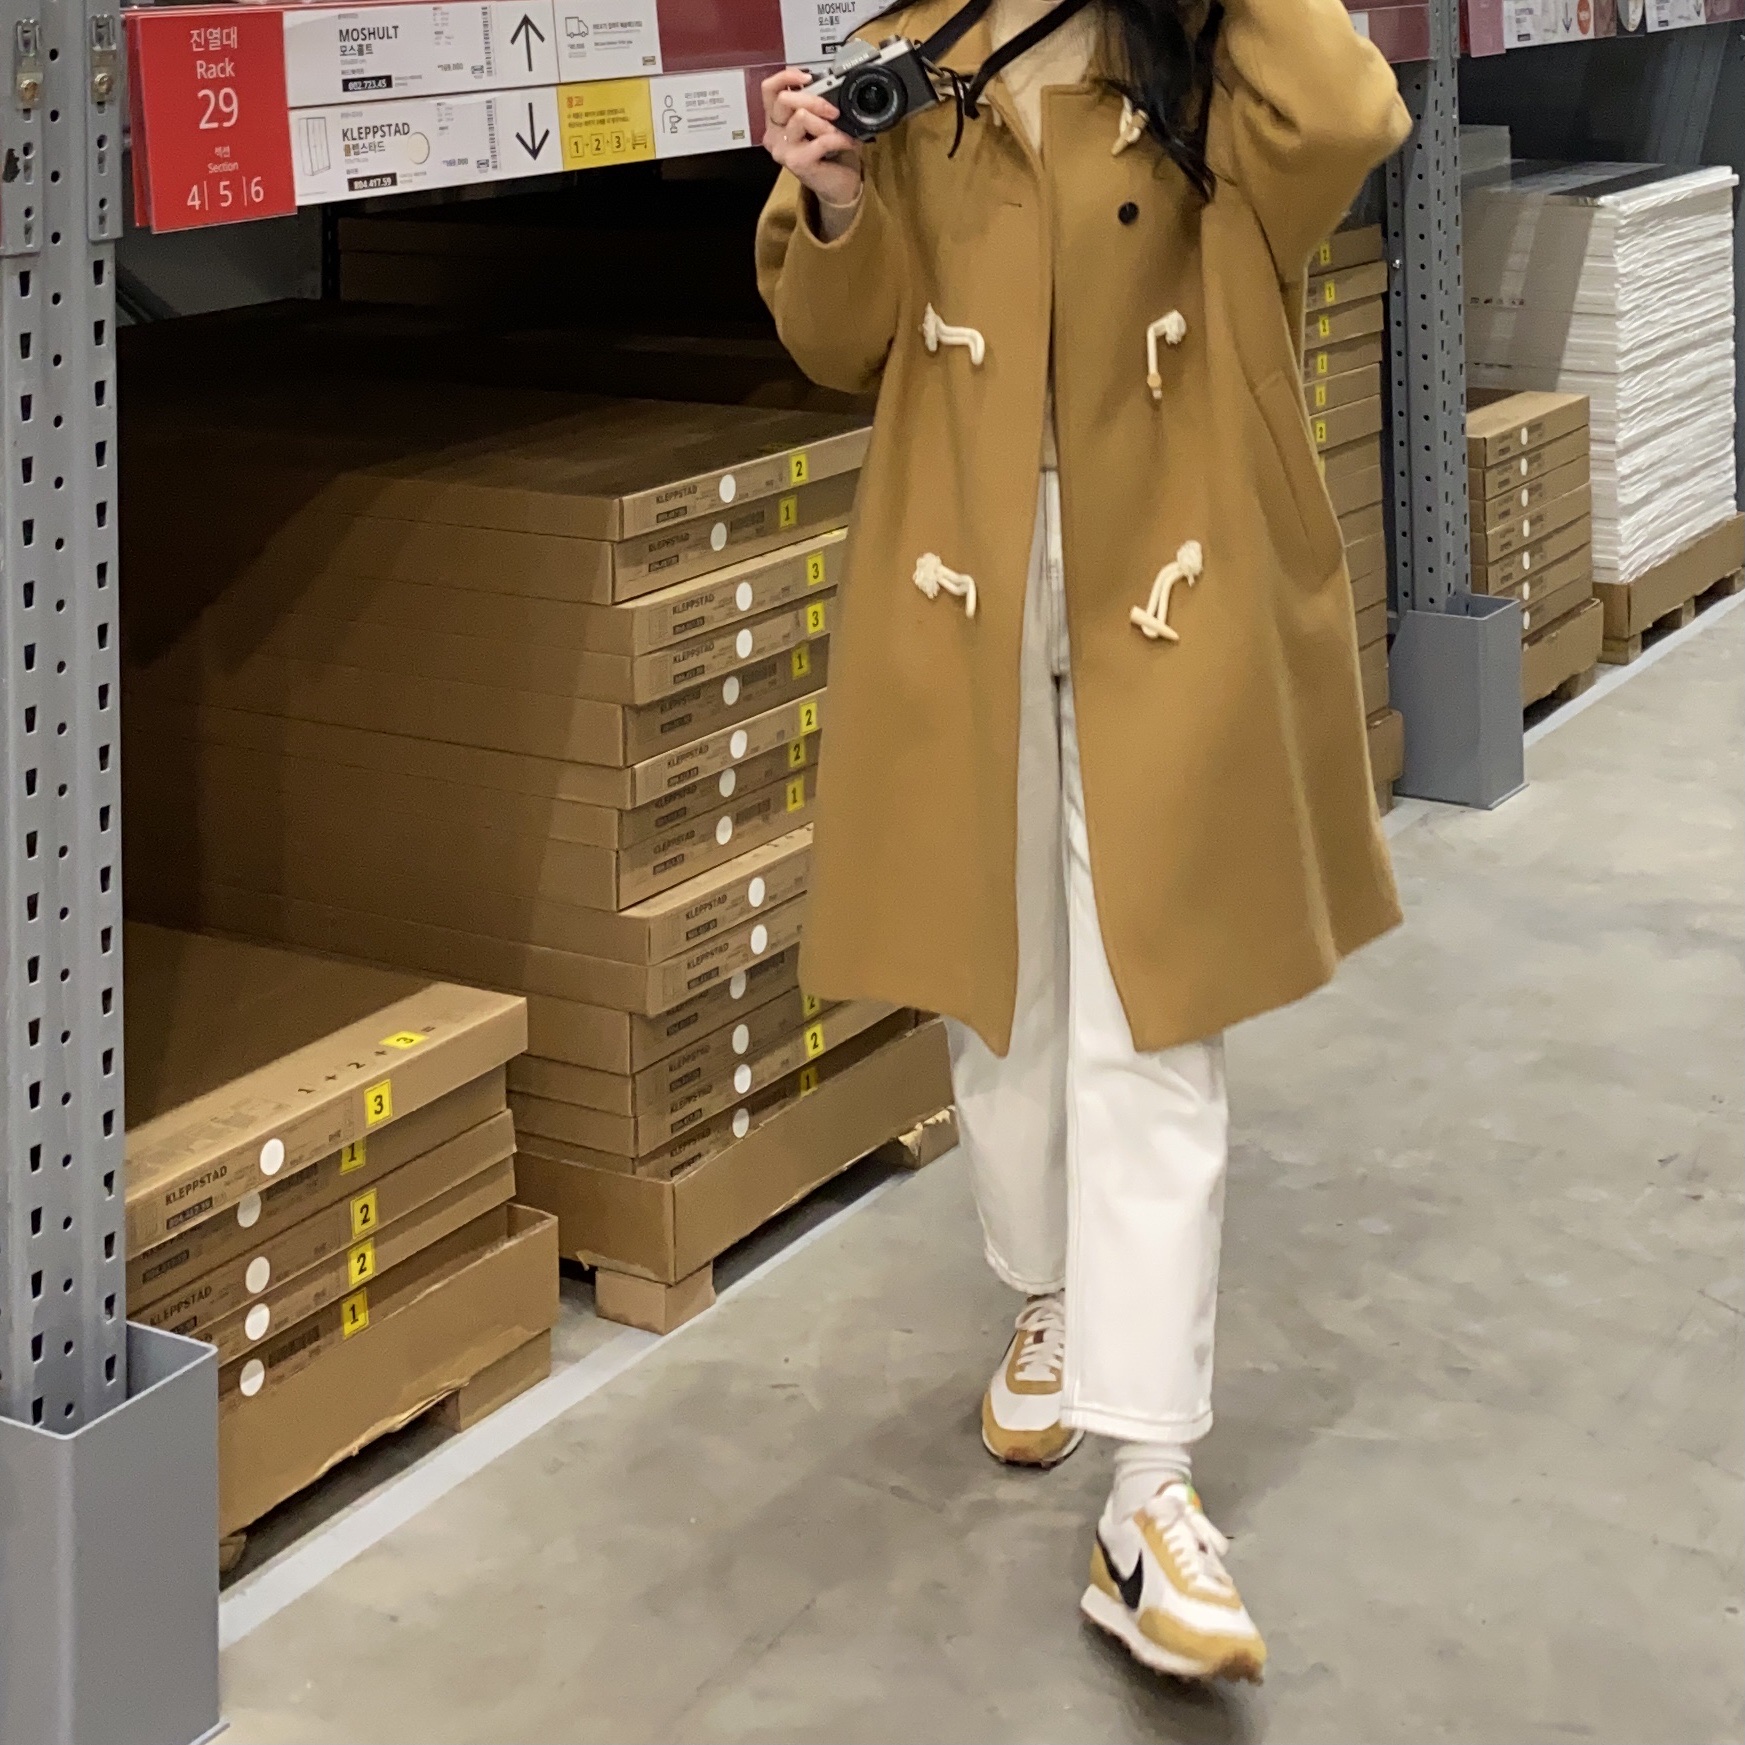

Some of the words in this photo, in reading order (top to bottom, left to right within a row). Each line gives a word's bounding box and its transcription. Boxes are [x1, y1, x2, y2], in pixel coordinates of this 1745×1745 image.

[817, 1, 856, 15] MOSHULT
[189, 26, 238, 52] 진열대
[338, 25, 399, 43] MOSHULT
[195, 57, 236, 80] Rack
[197, 87, 239, 130] 29
[341, 122, 411, 142] KLEPPSTAD
[207, 161, 239, 174] Section
[186, 184, 202, 211] 4
[219, 180, 233, 207] 5
[250, 176, 265, 203] 6
[795, 461, 803, 477] 2
[655, 484, 698, 505] KLEPPSTAD
[811, 562, 820, 580] 3
[672, 593, 715, 615] KLEPPSTAD
[811, 611, 820, 628] 3
[805, 709, 813, 726] 2
[667, 744, 709, 769] KLEPPSTAD
[685, 894, 728, 921] KLEPPSTAD
[687, 942, 729, 970] KLEPPSTAD
[810, 1032, 819, 1050] 2
[373, 1094, 384, 1116] 3
[347, 1143, 357, 1163] 1
[164, 1164, 228, 1207] KLEPPSTAD
[359, 1203, 371, 1225] 2
[357, 1252, 368, 1275] 2
[149, 1285, 213, 1326] KLEPPSTAD
[349, 1304, 359, 1325] 1
